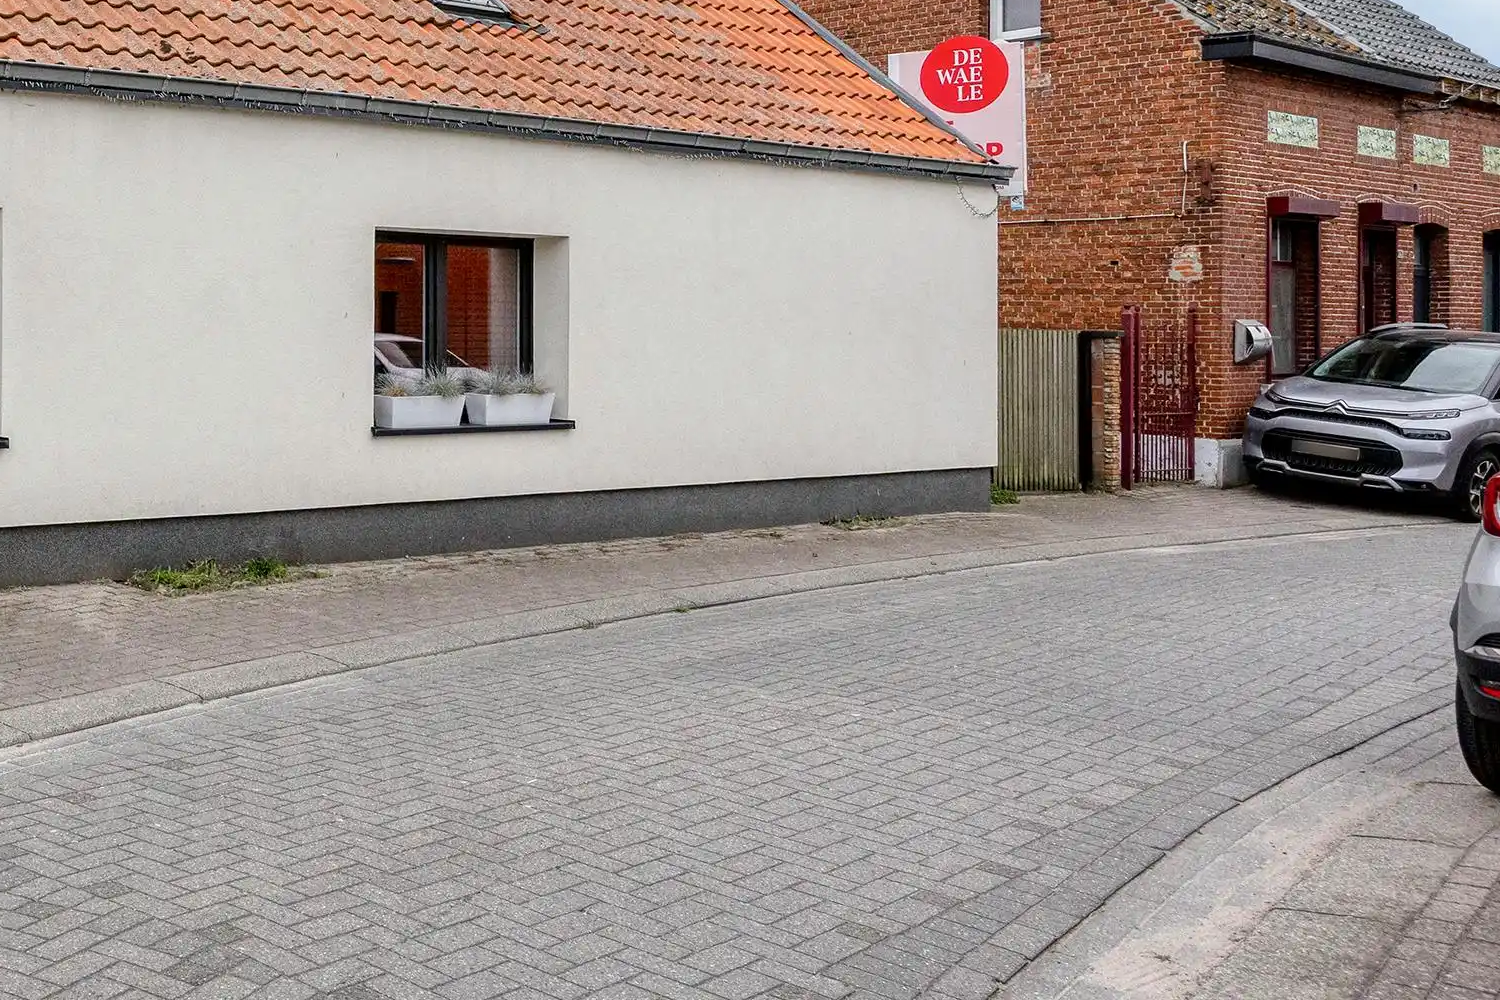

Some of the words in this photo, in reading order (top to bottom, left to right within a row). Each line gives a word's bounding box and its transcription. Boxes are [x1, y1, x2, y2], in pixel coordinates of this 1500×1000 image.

[952, 48, 982, 66] DE
[936, 66, 983, 85] WAE
[957, 84, 983, 101] LE
